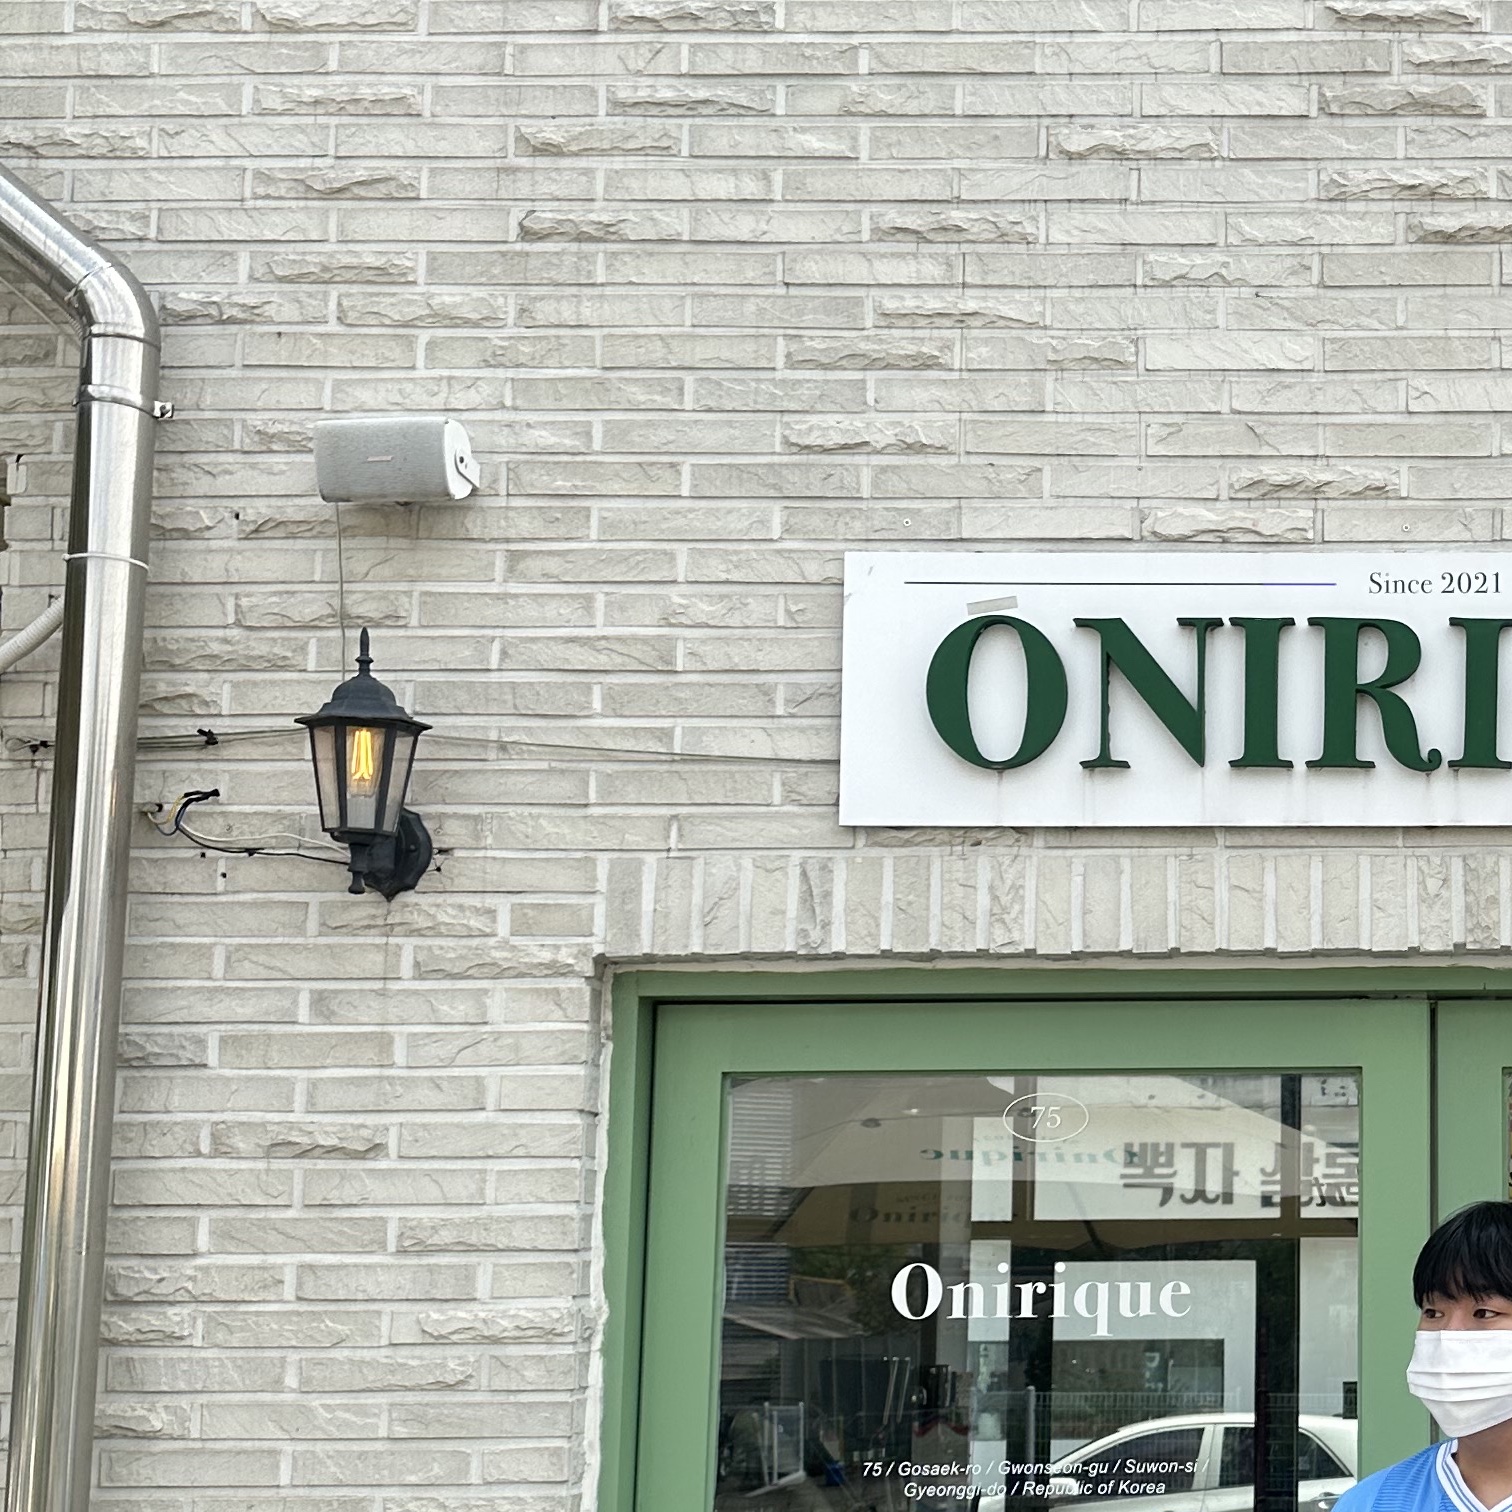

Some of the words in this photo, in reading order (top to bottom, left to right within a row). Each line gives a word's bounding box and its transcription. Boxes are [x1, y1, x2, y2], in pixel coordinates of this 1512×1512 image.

[1368, 571, 1433, 595] Since
[1440, 570, 1501, 595] 2021
[1030, 1105, 1062, 1130] 75
[890, 1260, 1193, 1338] Onirique
[861, 1461, 882, 1477] 75
[897, 1460, 982, 1477] Gosaek-ro
[997, 1459, 1109, 1479] Gwonseon-gu
[1124, 1458, 1198, 1475] Suwon-si
[903, 1481, 1007, 1500] Gyeonggi-do
[1022, 1480, 1094, 1499] Republic
[1097, 1480, 1115, 1496] of
[1117, 1480, 1167, 1496] Korea
